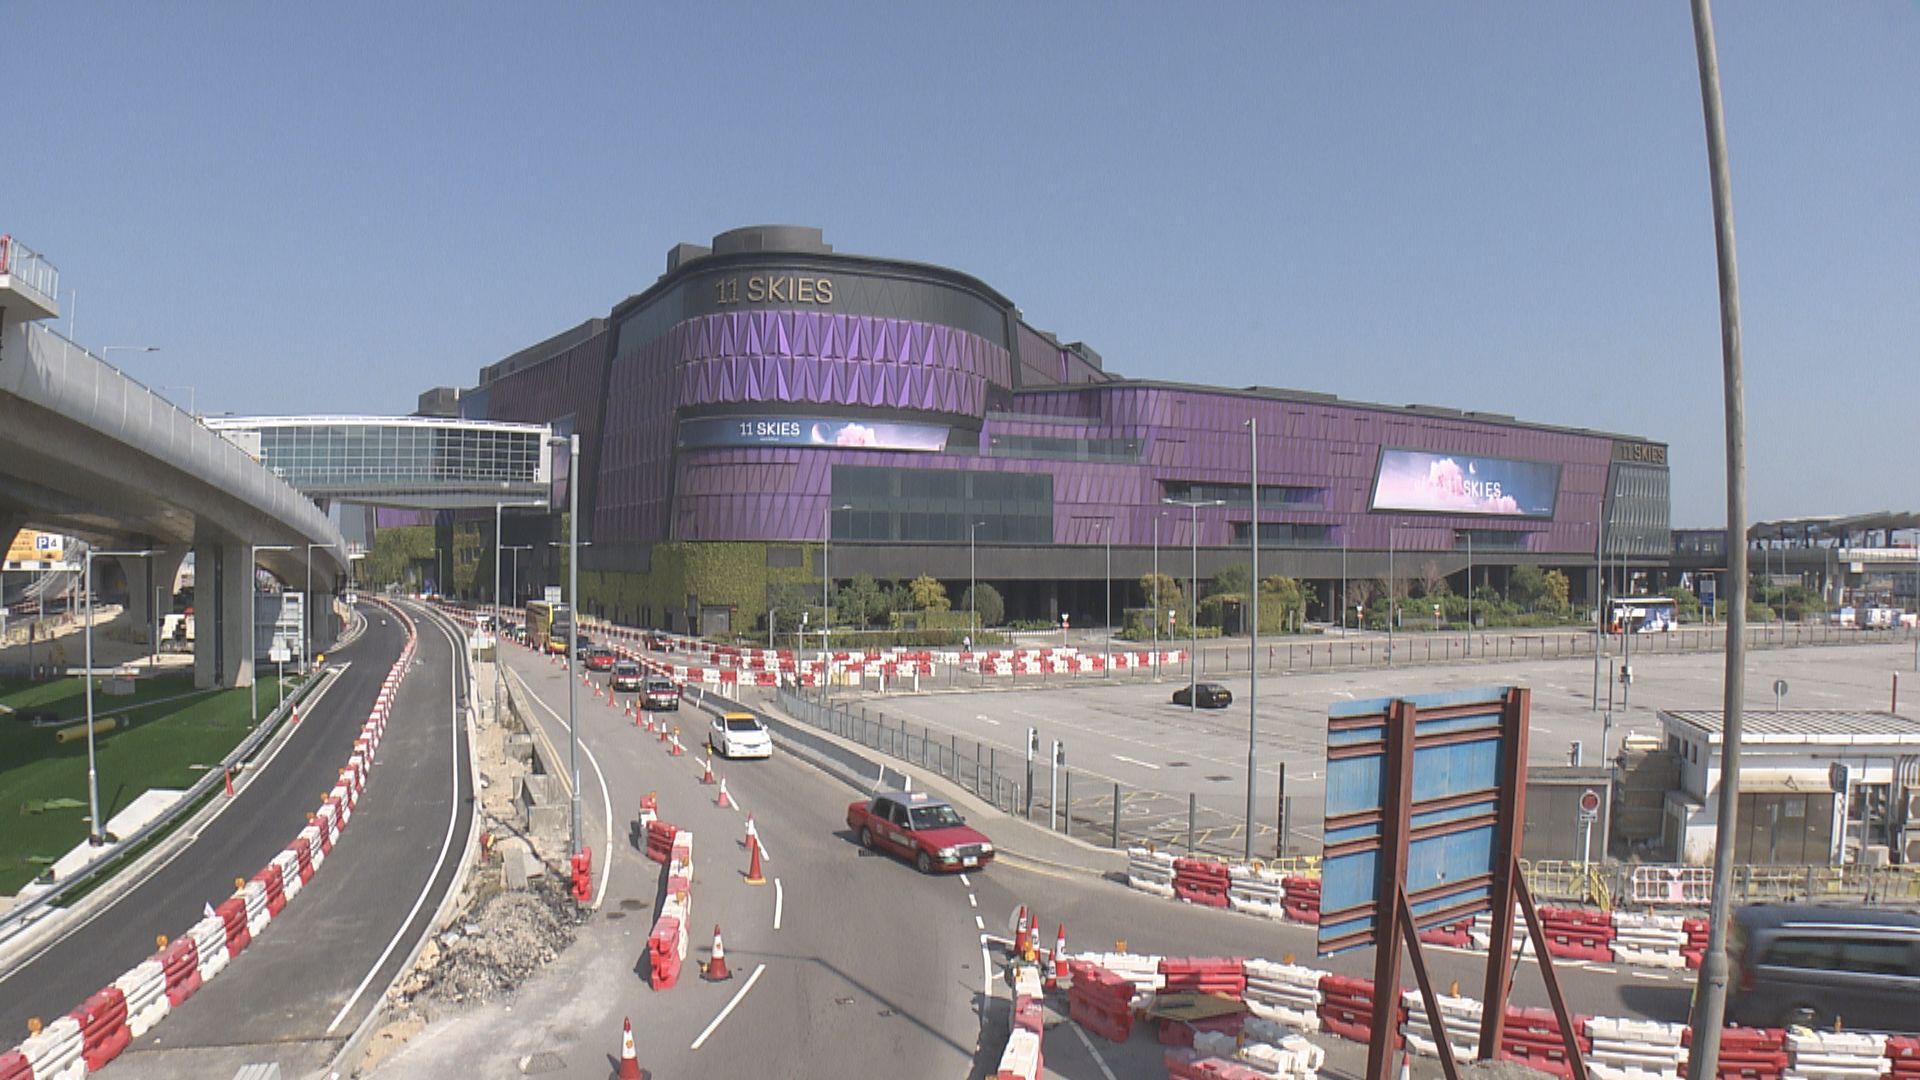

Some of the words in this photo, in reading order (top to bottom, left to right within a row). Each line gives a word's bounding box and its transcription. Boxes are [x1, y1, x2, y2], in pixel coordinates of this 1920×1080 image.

[716, 278, 739, 303] 11
[747, 276, 833, 304] SKIES
[740, 422, 753, 436] 11
[757, 422, 800, 436] SKIES
[1634, 444, 1665, 464] SKIES
[1463, 480, 1501, 497] SKIES
